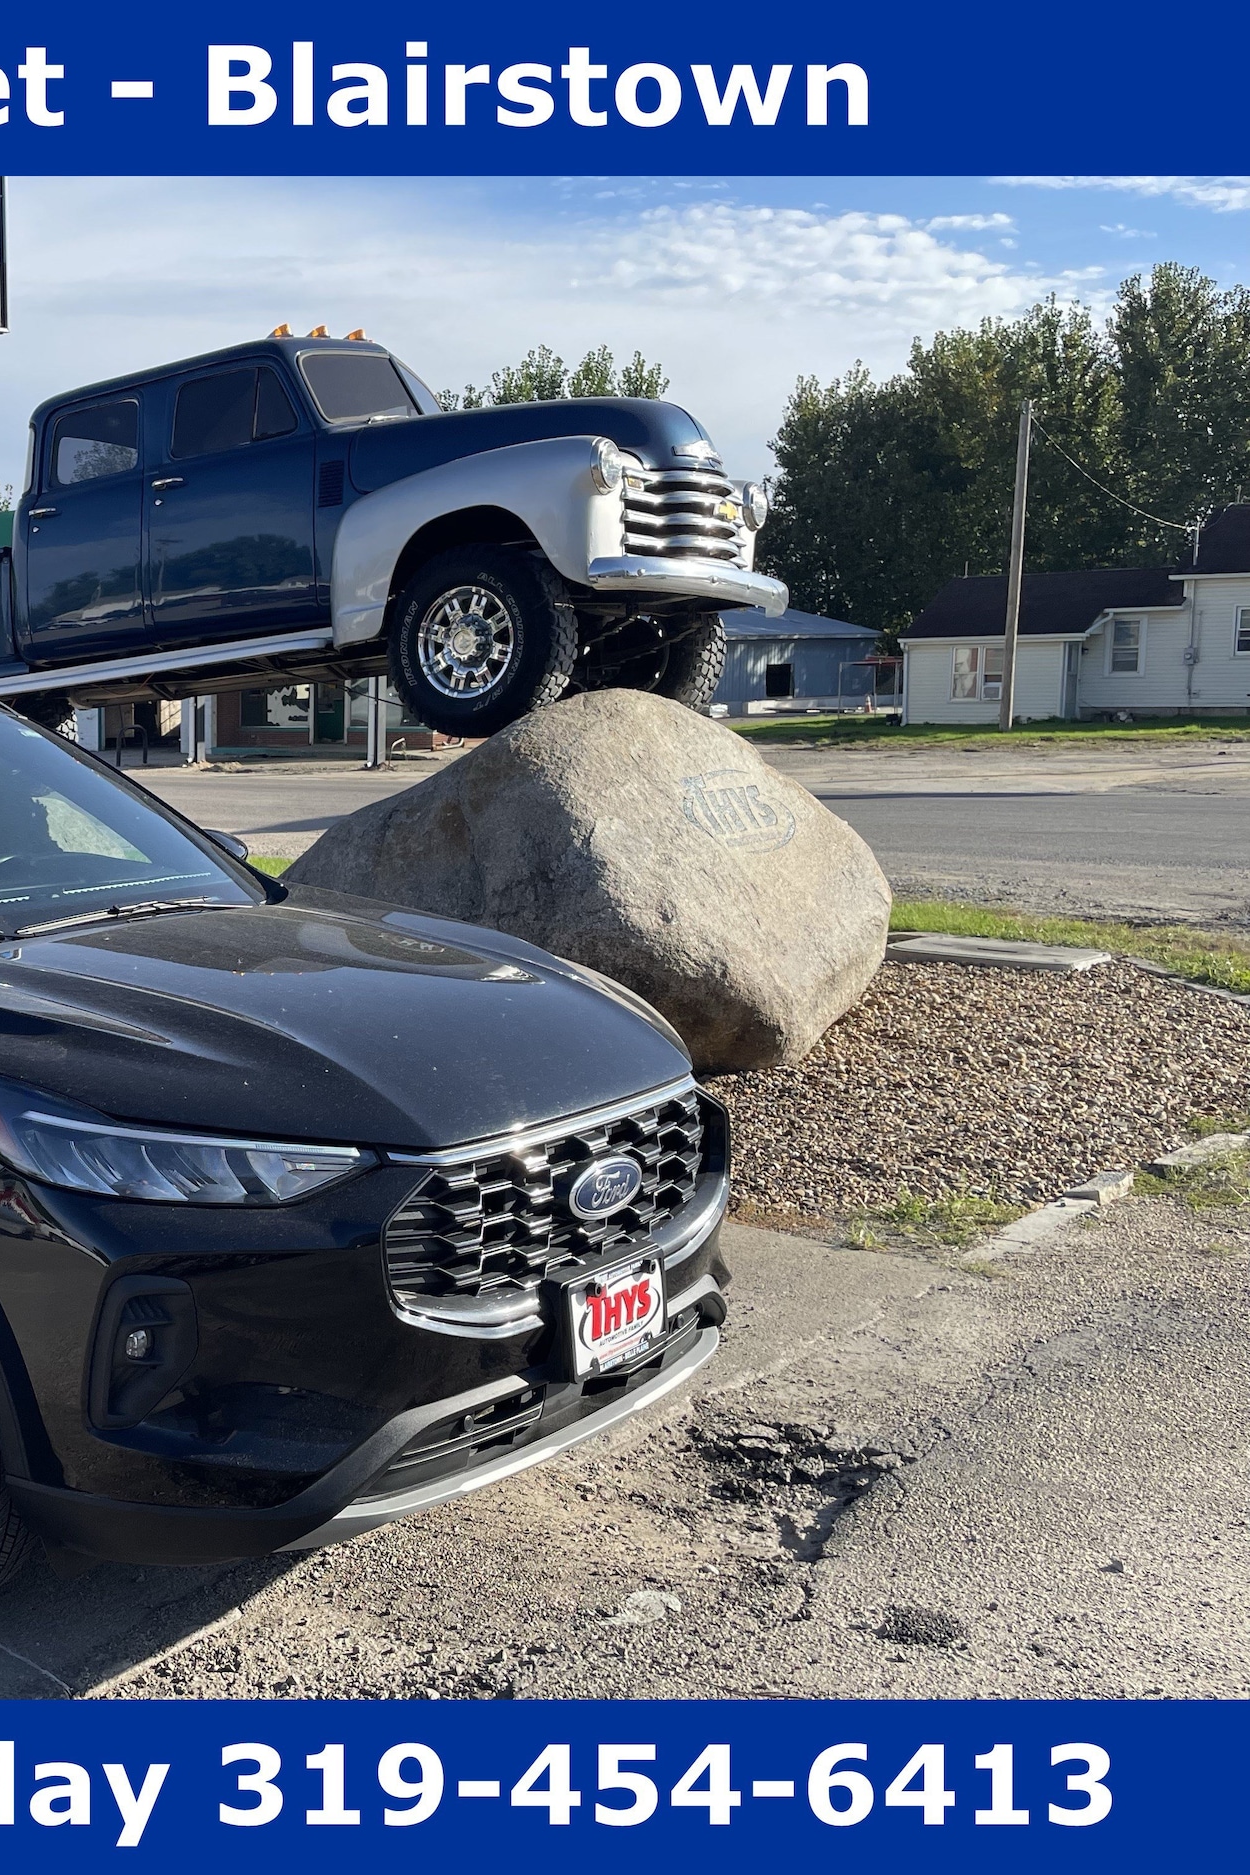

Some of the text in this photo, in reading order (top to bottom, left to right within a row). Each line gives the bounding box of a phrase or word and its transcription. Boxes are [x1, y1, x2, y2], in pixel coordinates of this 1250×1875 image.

[400, 601, 418, 687] IRONMAN
[477, 572, 504, 593] ALL
[506, 594, 524, 683] COUNTRY
[680, 772, 779, 834] THYS
[592, 1170, 631, 1209] Ford
[585, 1278, 652, 1341] THYS
